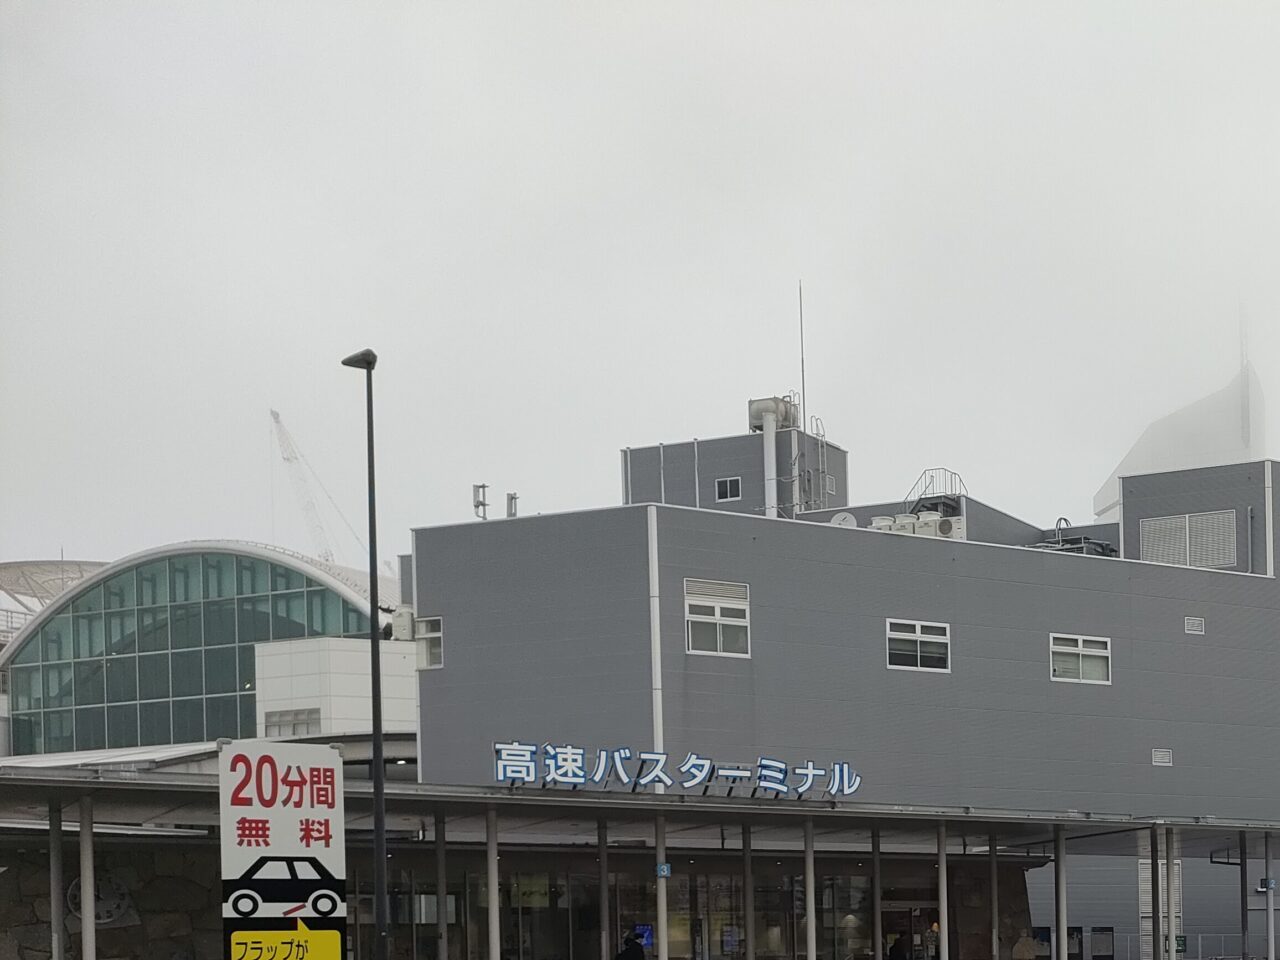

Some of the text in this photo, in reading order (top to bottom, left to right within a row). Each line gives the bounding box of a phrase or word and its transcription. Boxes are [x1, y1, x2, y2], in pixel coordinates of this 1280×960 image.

[229, 753, 336, 809] 20分間
[494, 740, 862, 796] 高速バスターミナル
[236, 816, 333, 848] 無料
